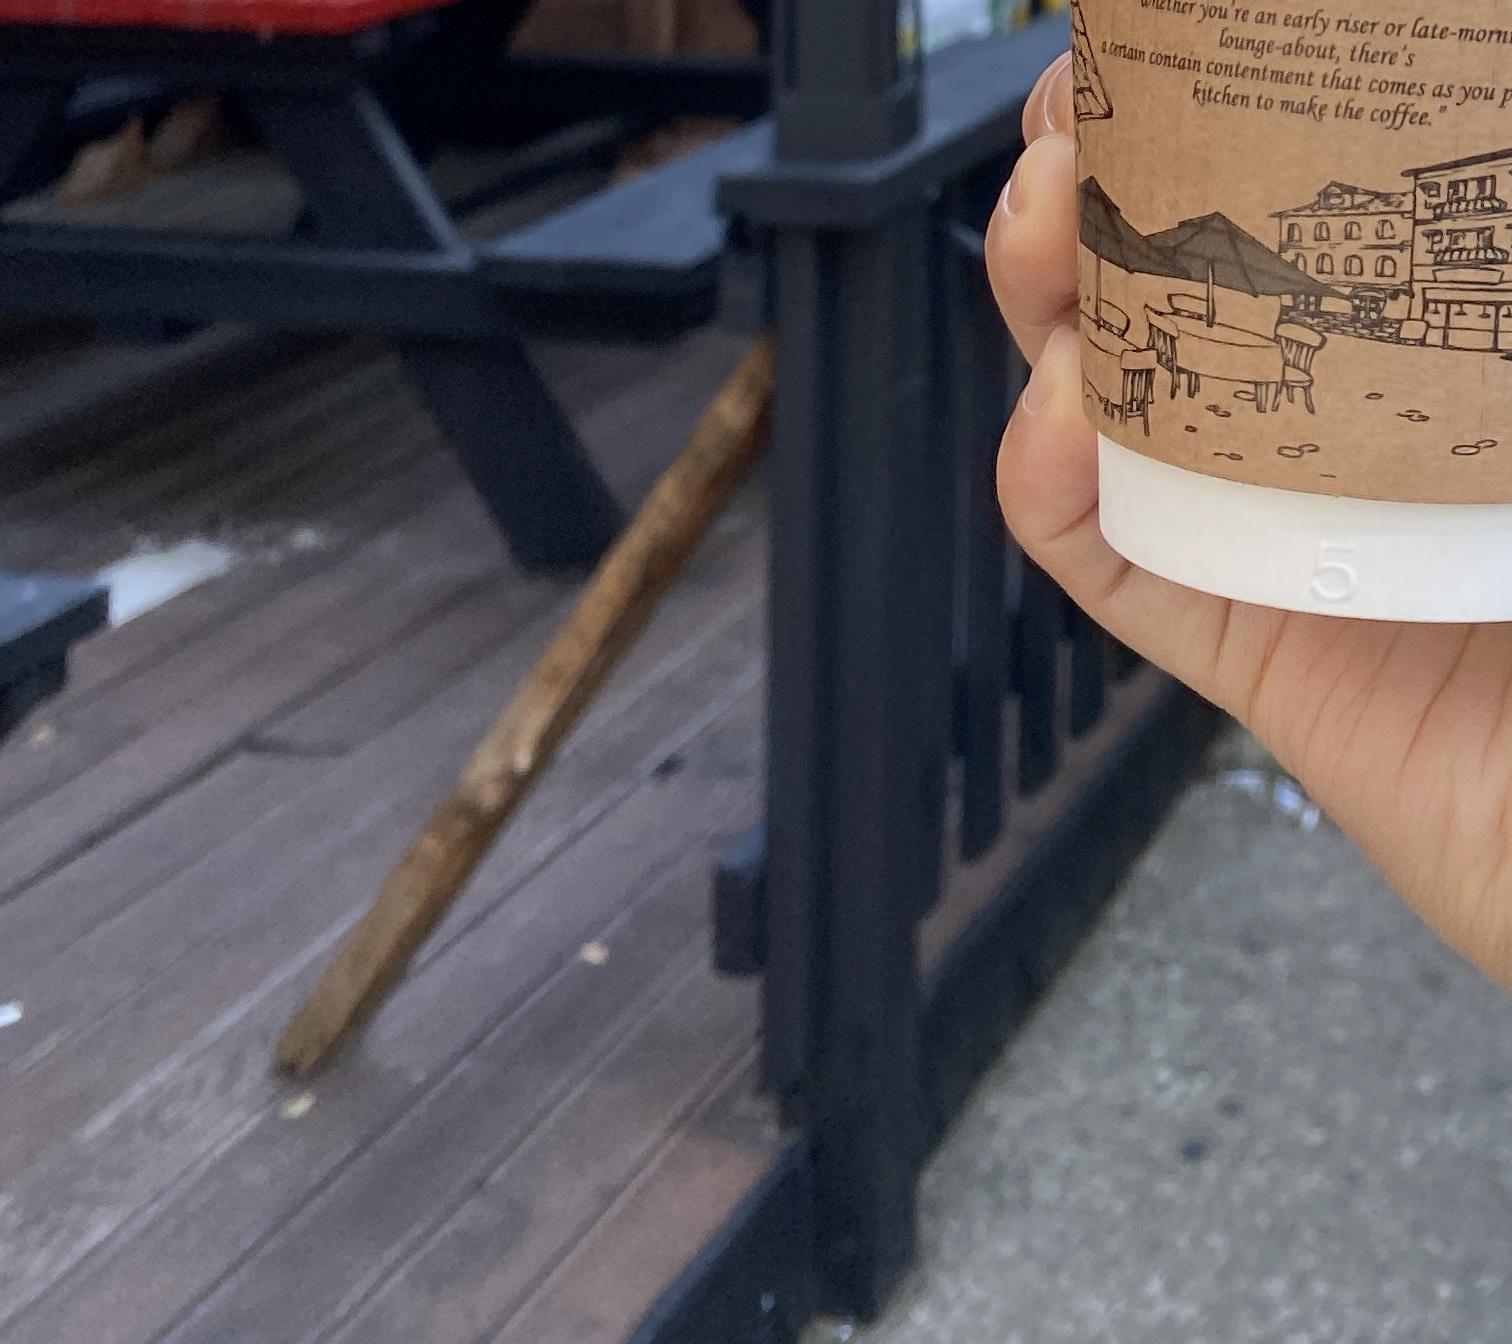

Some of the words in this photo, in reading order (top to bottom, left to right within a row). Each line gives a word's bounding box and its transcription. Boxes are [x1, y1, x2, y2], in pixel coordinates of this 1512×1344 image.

[1197, 0, 1250, 23] you're
[1254, 9, 1277, 26] an
[1283, 9, 1330, 37] early
[1335, 14, 1381, 35] riser
[1384, 21, 1407, 38] or
[1218, 27, 1341, 64] lounge-about,
[1349, 41, 1416, 68] there's
[1101, 40, 1108, 54] a
[1109, 40, 1146, 63] certain
[1149, 50, 1201, 73] contain
[1206, 58, 1314, 88] contentment
[1320, 68, 1362, 92] that
[1368, 78, 1427, 98] comes
[1432, 81, 1454, 99] as
[1456, 84, 1497, 106] you
[1192, 80, 1251, 109] kitchen
[1256, 94, 1275, 112] to
[1279, 95, 1328, 122] make
[1333, 98, 1364, 120] the
[1311, 540, 1359, 604] 5
